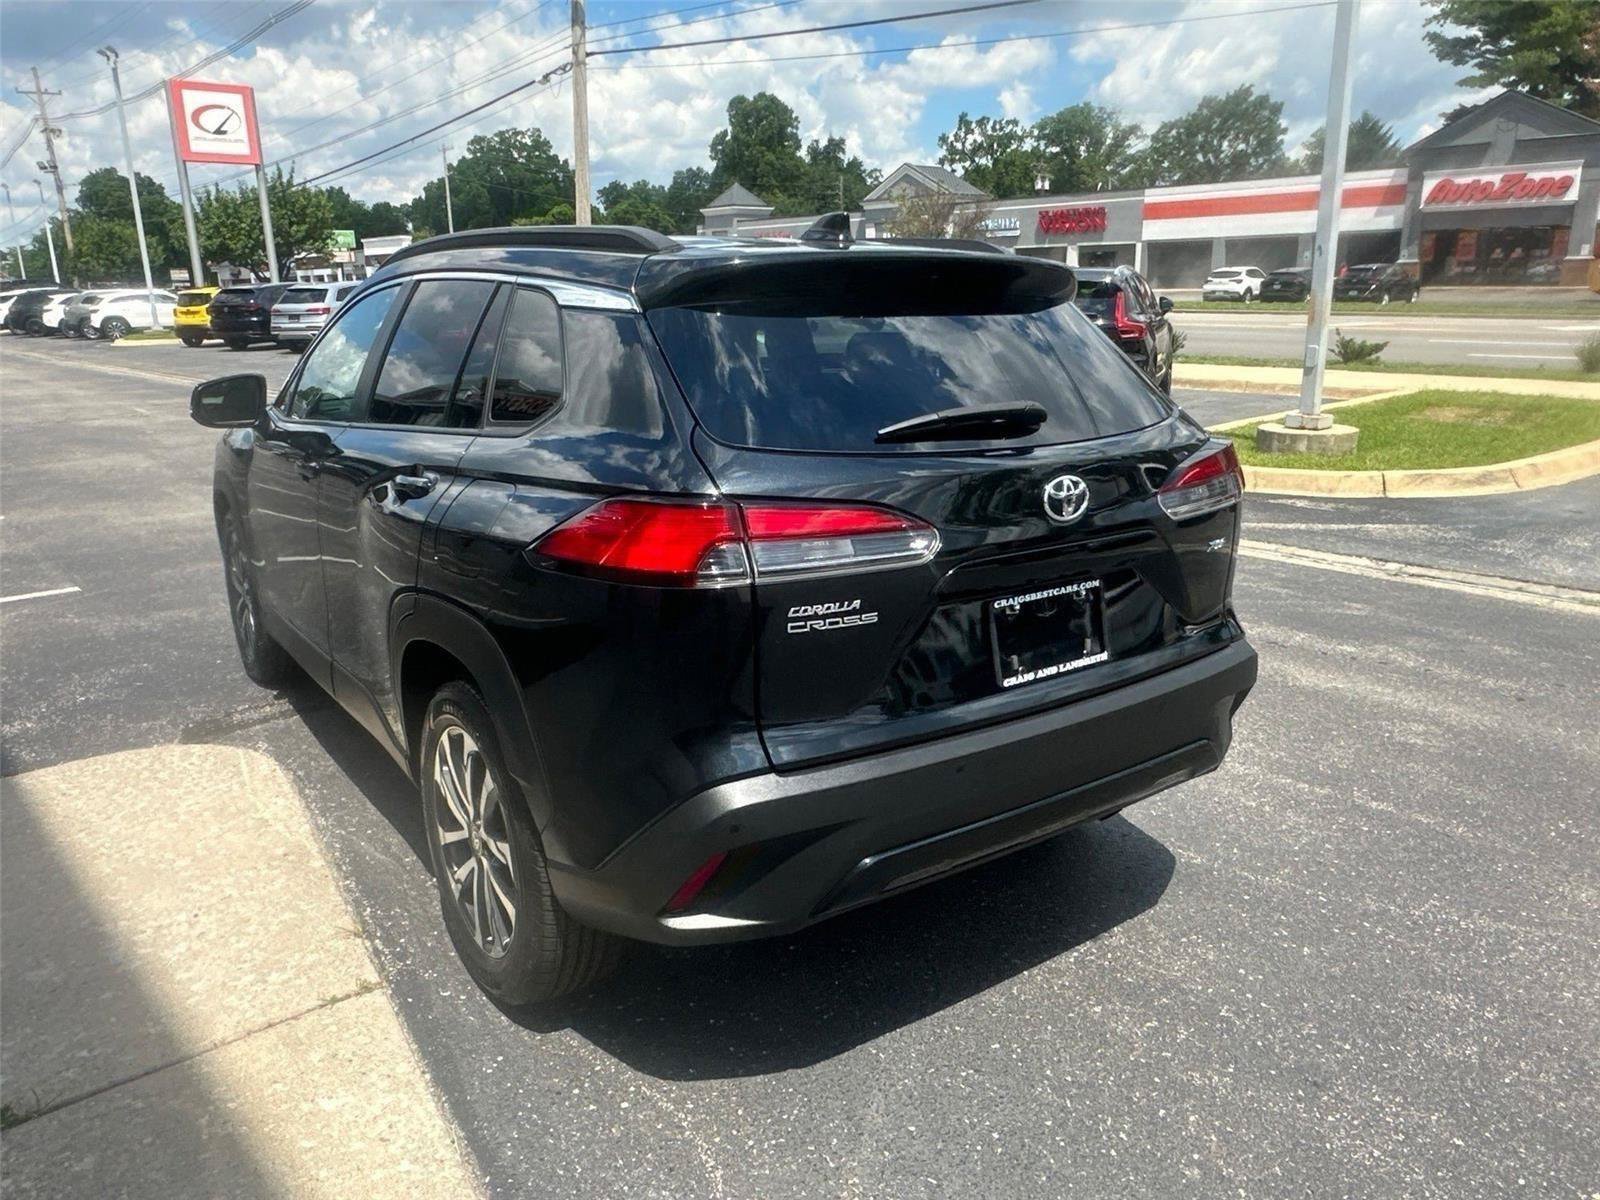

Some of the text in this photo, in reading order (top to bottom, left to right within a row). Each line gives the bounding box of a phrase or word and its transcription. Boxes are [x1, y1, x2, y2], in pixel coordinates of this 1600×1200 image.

[1424, 173, 1575, 204] AutoZone
[993, 579, 1100, 609] CRAIGSBESTCARS.COM
[787, 599, 861, 618] COROLLA
[787, 612, 878, 634] CROSS
[1036, 664, 1059, 679] AND
